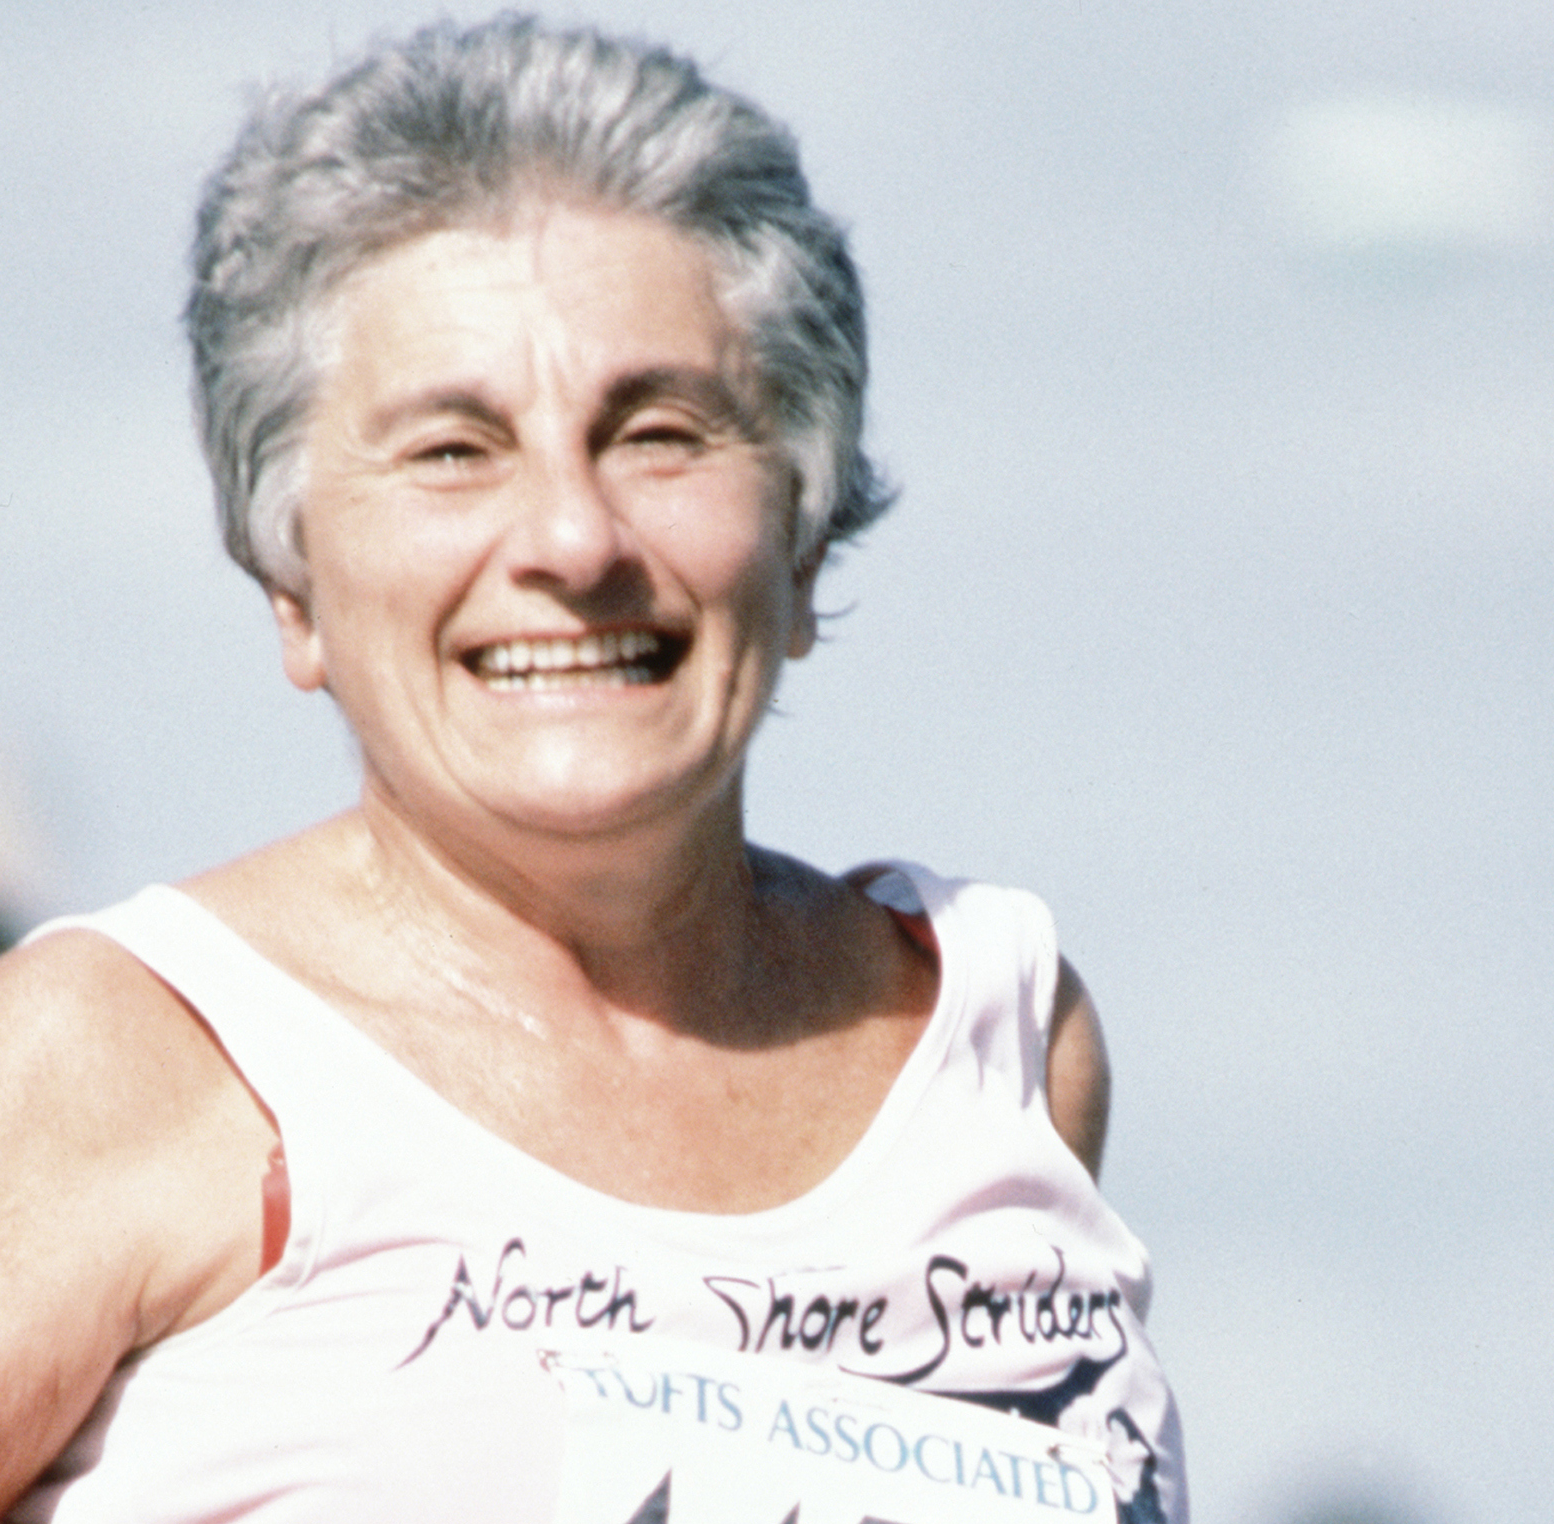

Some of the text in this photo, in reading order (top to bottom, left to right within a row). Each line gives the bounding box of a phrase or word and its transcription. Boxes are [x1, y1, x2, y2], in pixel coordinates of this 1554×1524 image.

[390, 1237, 1130, 1387] North Shore Striders
[572, 1367, 1099, 1515] TUFTS ASSOCIATED
